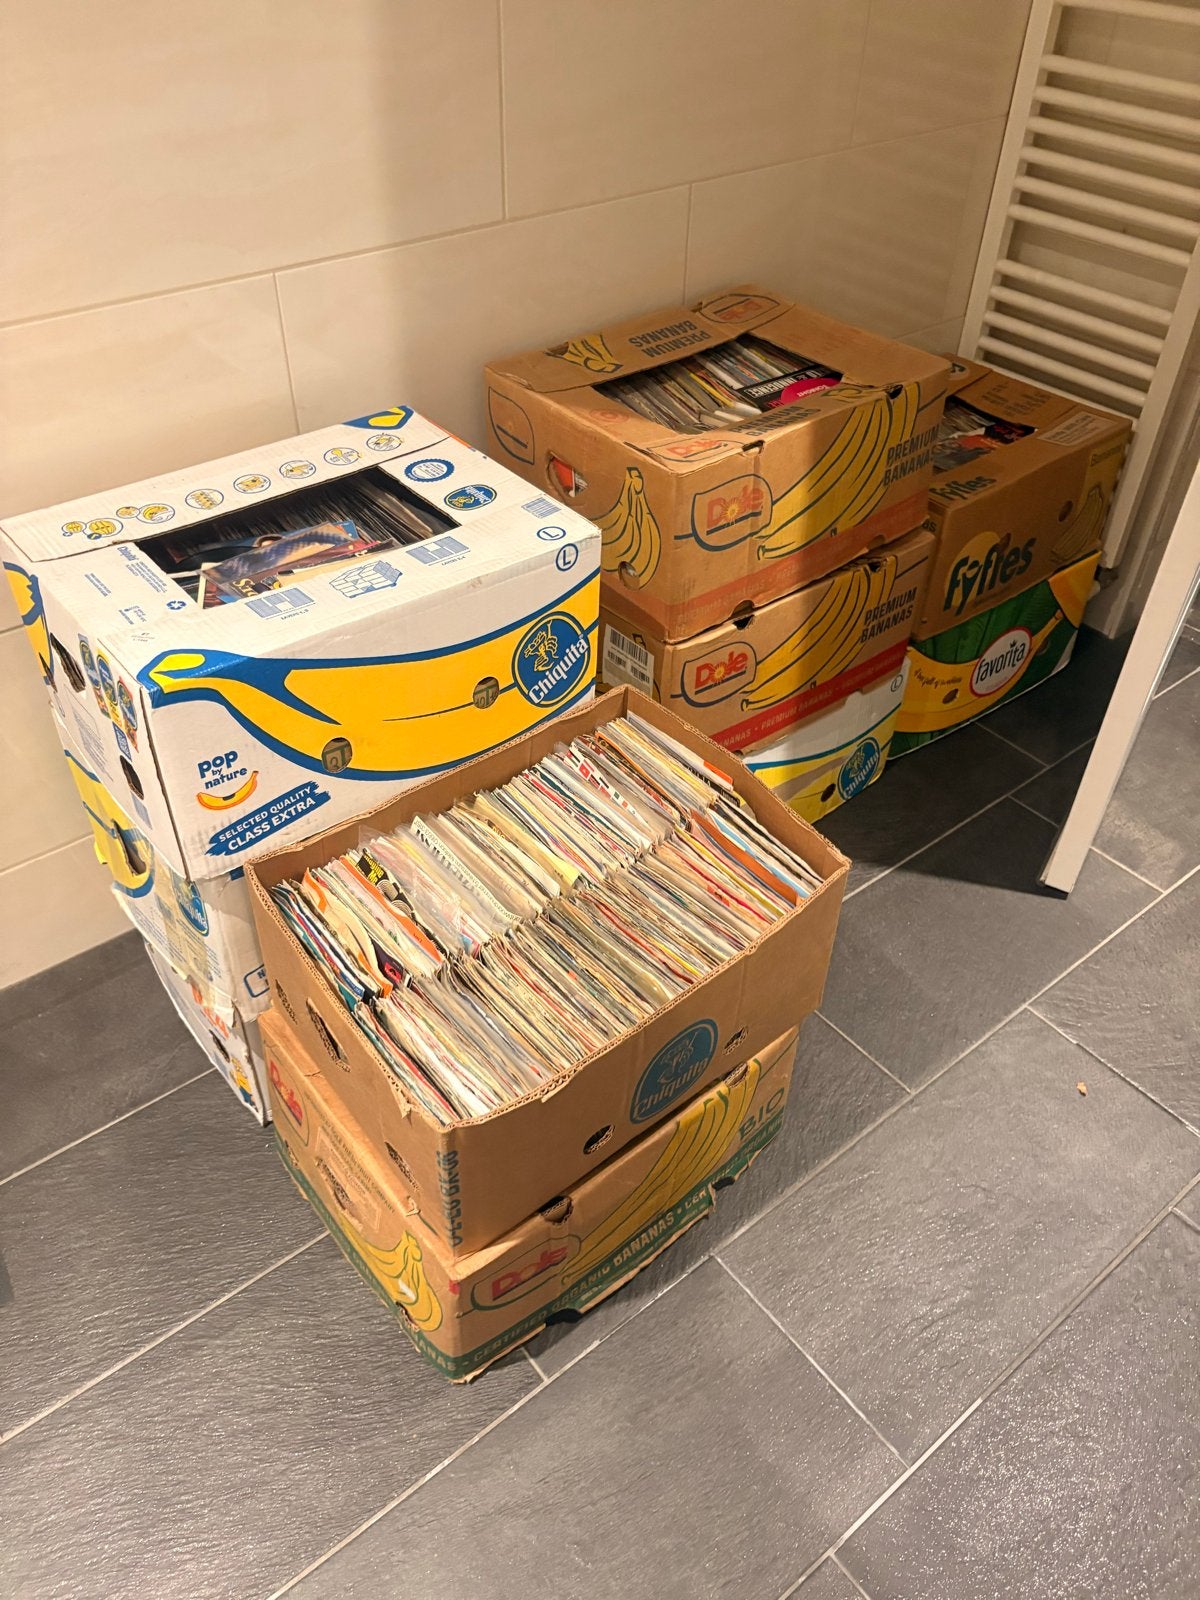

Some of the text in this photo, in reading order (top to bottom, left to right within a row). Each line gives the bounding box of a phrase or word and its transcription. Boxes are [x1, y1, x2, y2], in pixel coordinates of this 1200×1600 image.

[628, 320, 698, 348] BANANAS
[641, 330, 712, 358] PREMIUM
[729, 405, 807, 433] PREMIUM
[745, 408, 821, 437] BANANAS
[887, 423, 939, 467] PREMIUM
[707, 484, 764, 527] Dole
[943, 537, 1037, 617] fyffes
[860, 607, 913, 644] BANANAS
[864, 587, 918, 625] PREMIUM
[528, 637, 589, 705] Chiquita
[694, 651, 748, 690] Dole
[974, 641, 1027, 685] favorita
[761, 709, 798, 729] PREMIUM
[197, 750, 239, 779] pop
[205, 768, 248, 790] nature
[211, 767, 223, 777] by
[843, 750, 879, 799] Chiquita
[219, 786, 312, 842] SELECTED QUALITY
[228, 797, 316, 851] CLASS EXTRA
[269, 1059, 304, 1121] Dole
[633, 1057, 708, 1120] Chiquita
[739, 1088, 785, 1140] BIO
[473, 1211, 675, 1362] CERTIFIED ORGANIC BANANAS
[491, 1247, 568, 1298] Dole
